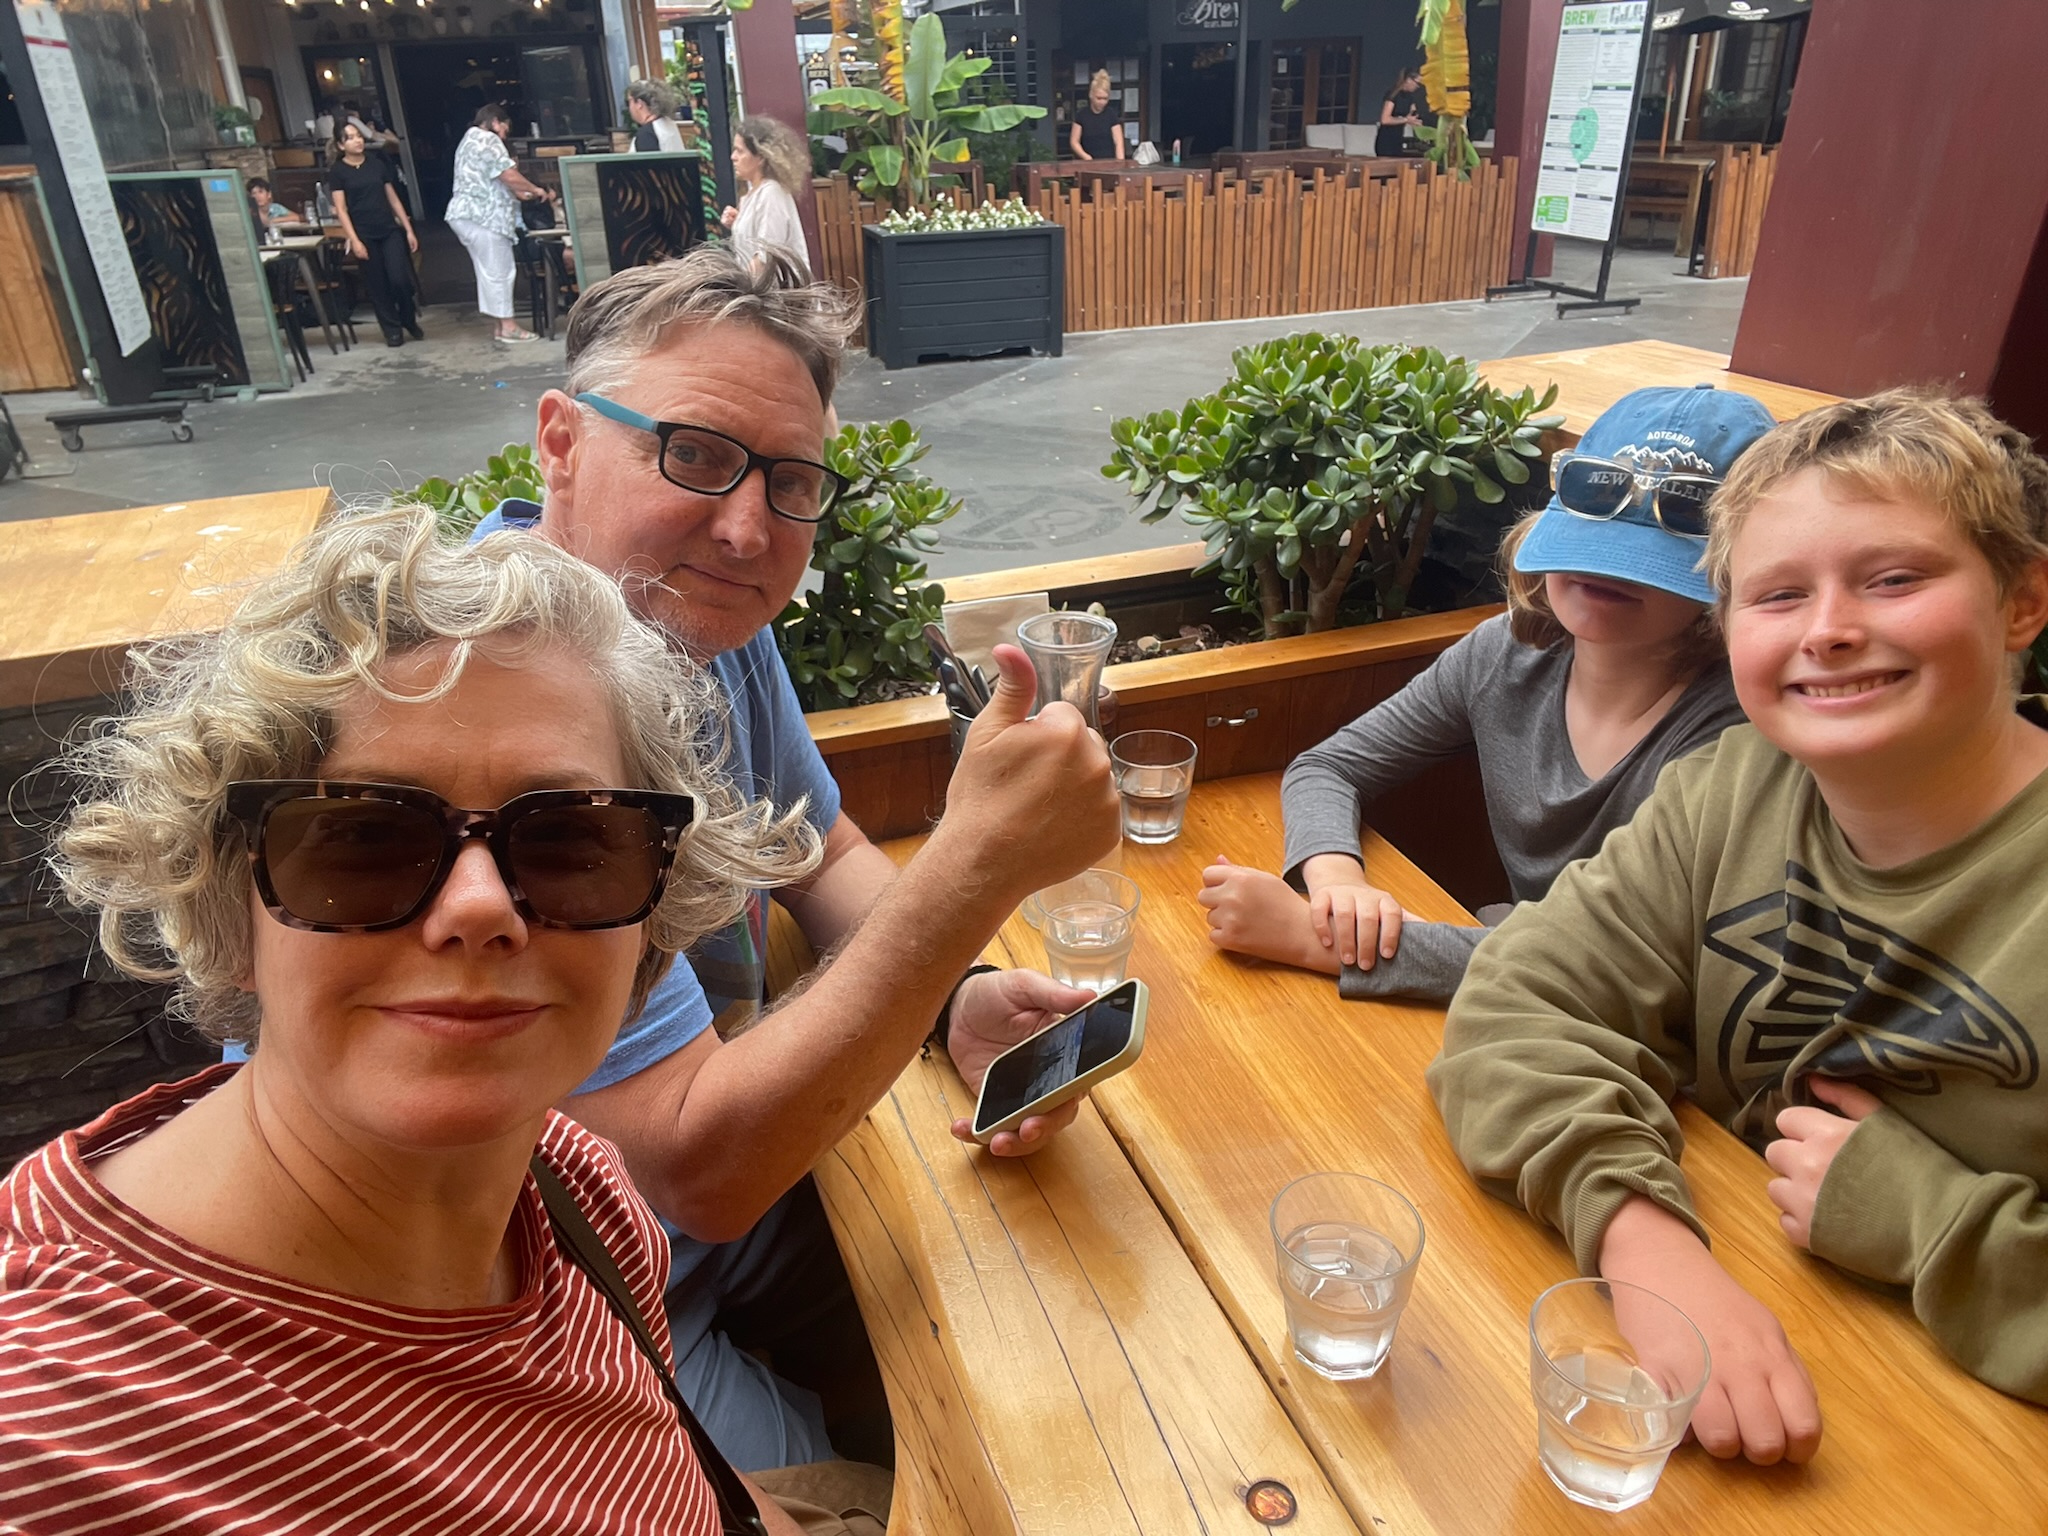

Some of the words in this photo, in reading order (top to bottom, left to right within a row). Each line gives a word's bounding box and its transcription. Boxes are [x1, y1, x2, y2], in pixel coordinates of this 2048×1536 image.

[1564, 10, 1598, 26] BREW
[1647, 431, 1696, 448] AOTEAROA
[1587, 471, 1629, 486] NEW
